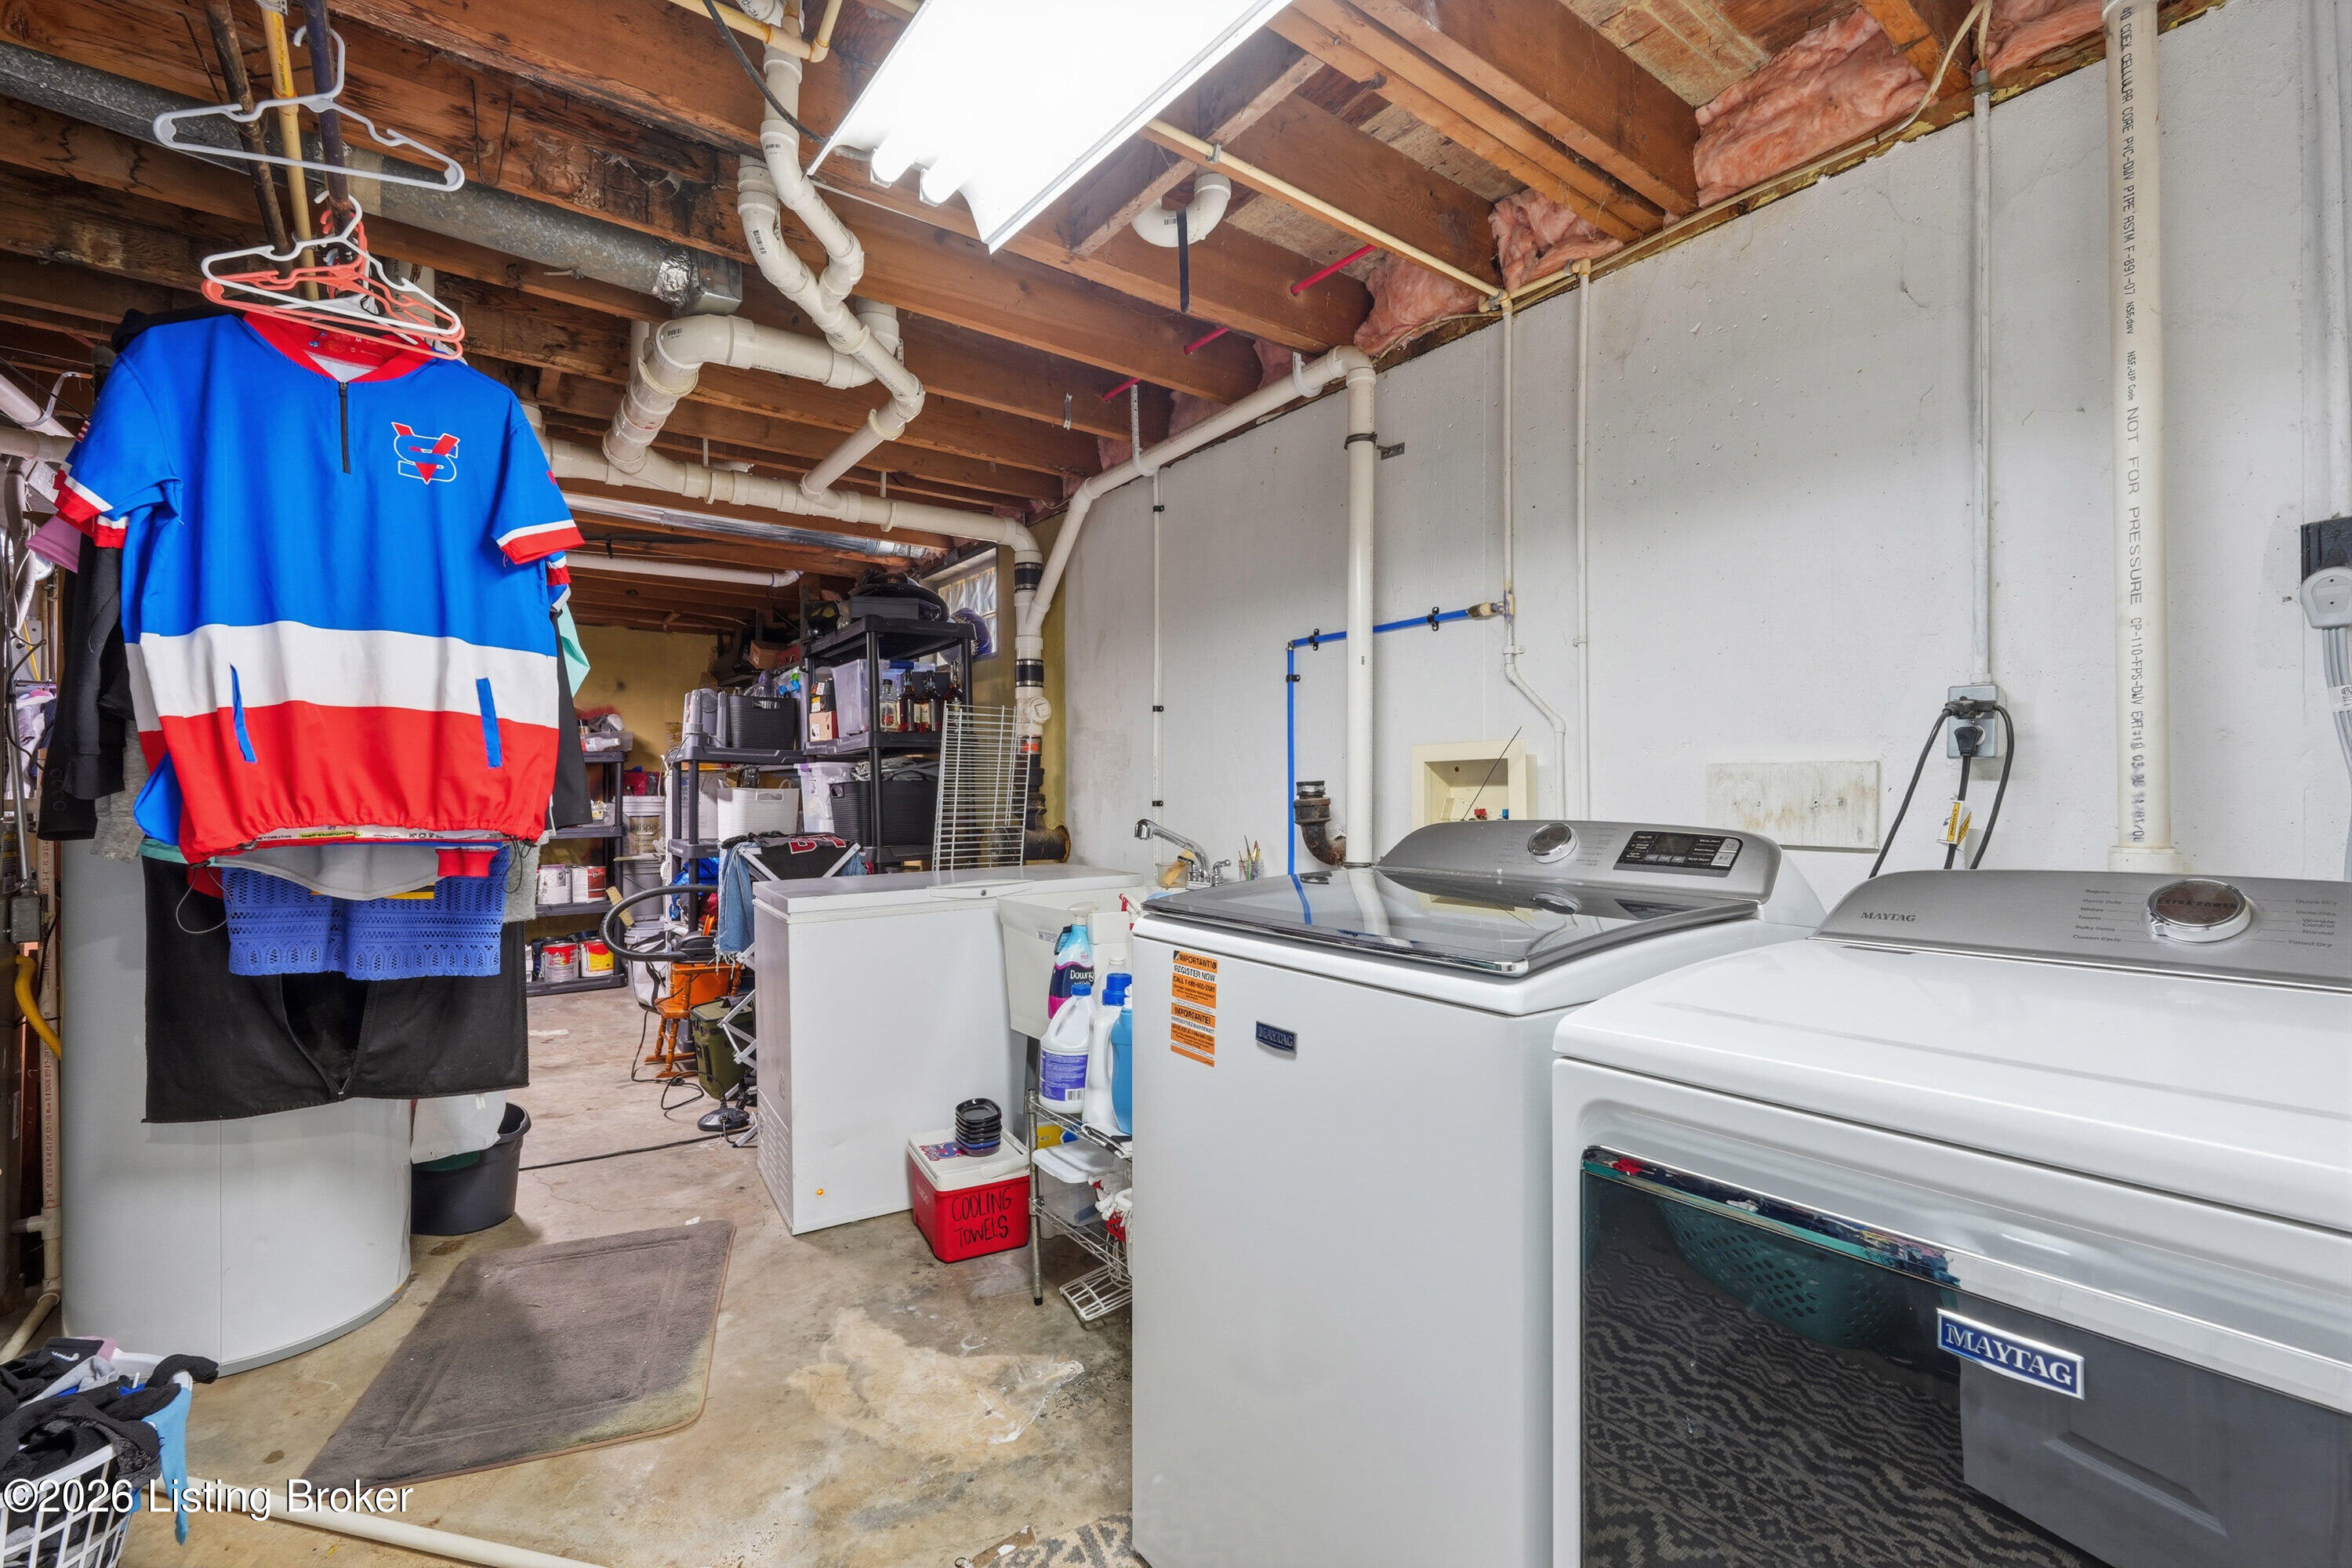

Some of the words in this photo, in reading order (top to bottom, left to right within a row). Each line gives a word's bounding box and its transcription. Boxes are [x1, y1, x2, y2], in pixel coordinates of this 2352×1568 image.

[2120, 24, 2132, 53] COEX
[2120, 53, 2133, 104] CELLULAR
[2122, 107, 2133, 133] CORE
[2122, 136, 2134, 180] PVC-DWV
[2123, 185, 2134, 212] PIPE
[2123, 216, 2134, 243] ASTM
[2124, 245, 2135, 296] F-891-07
[2127, 406, 2139, 442] NOT
[2128, 456, 2140, 495] FOR
[2129, 506, 2142, 605] PRESSURE
[1860, 913, 1916, 922] MAYTAG
[1069, 969, 1094, 982] Downy
[1201, 971, 1216, 982] NOW
[951, 1187, 1011, 1221] COOLING
[954, 1215, 1009, 1249] TOWELS
[1945, 1323, 2073, 1386] MAYTAG
